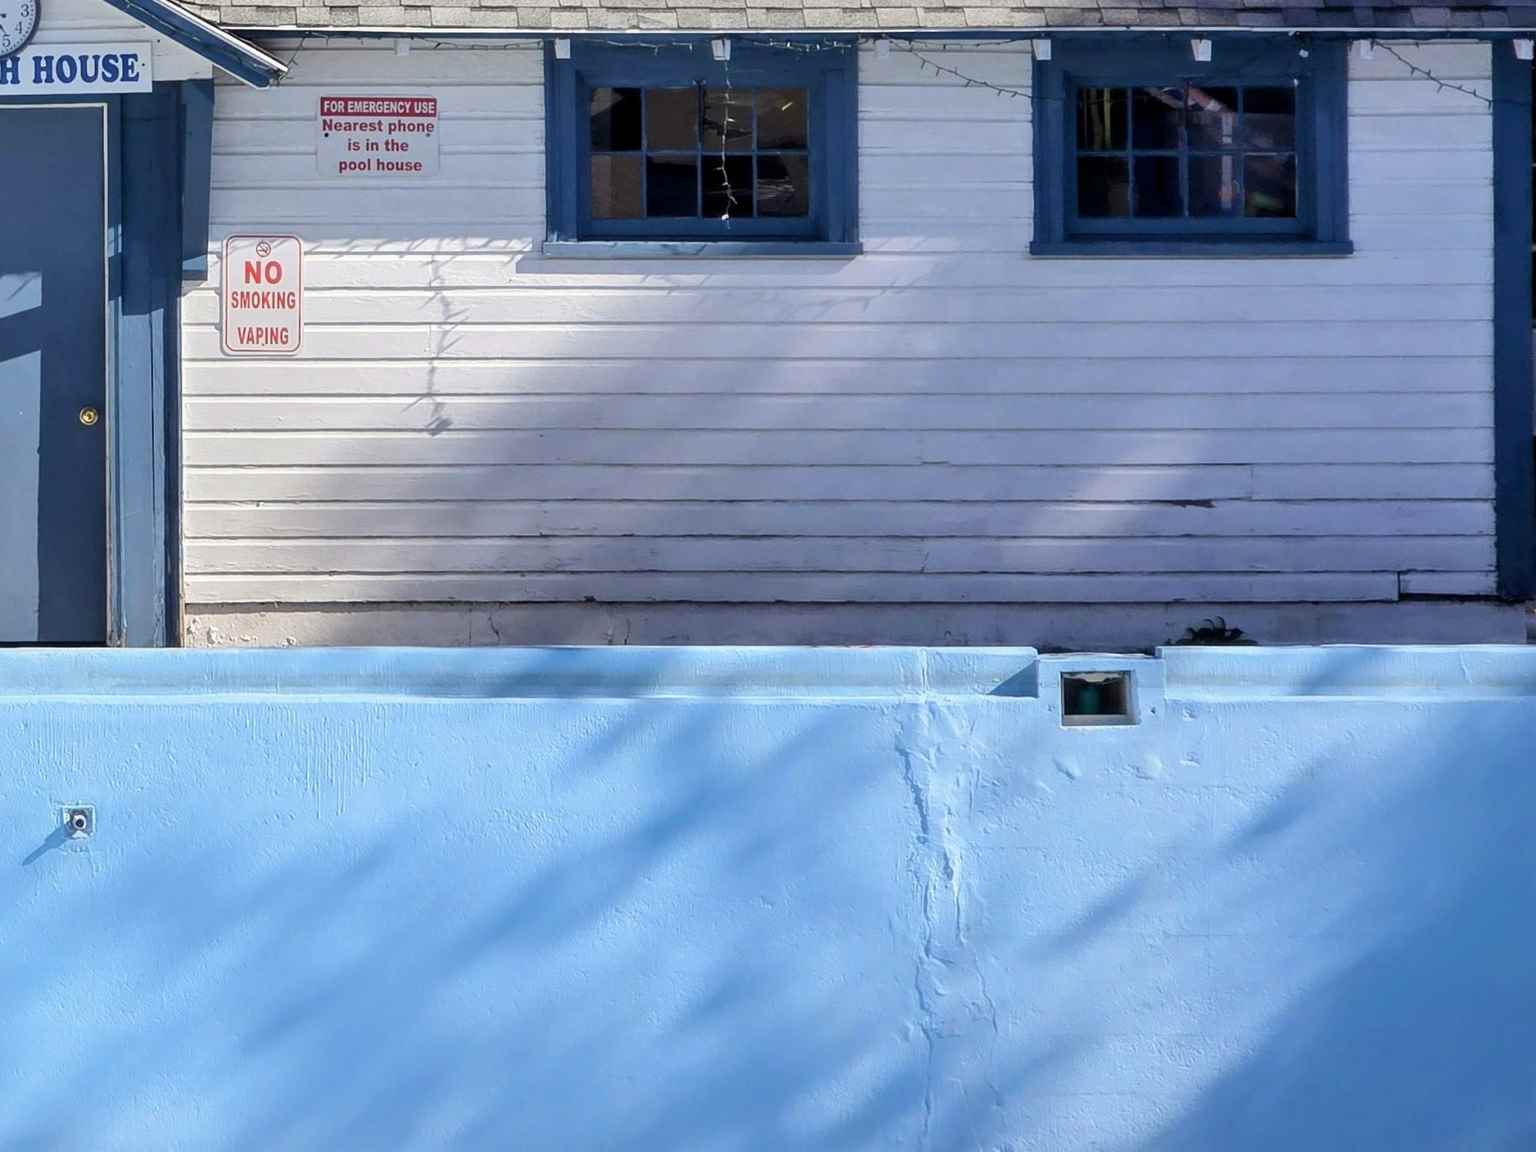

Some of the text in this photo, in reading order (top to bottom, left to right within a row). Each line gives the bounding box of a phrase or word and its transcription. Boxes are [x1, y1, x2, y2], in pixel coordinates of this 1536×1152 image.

[21, 4, 29, 17] 3
[15, 22, 22, 34] 4
[3, 34, 11, 48] 5
[32, 54, 140, 84] HOUSE
[324, 101, 435, 113] FOR EMERGENCY USE
[322, 119, 434, 134] Nearest phone
[348, 139, 409, 152] is in the
[339, 159, 422, 173] pool house
[244, 261, 282, 284] NO
[232, 291, 295, 309] SMOKING
[238, 327, 289, 345] VAPING
